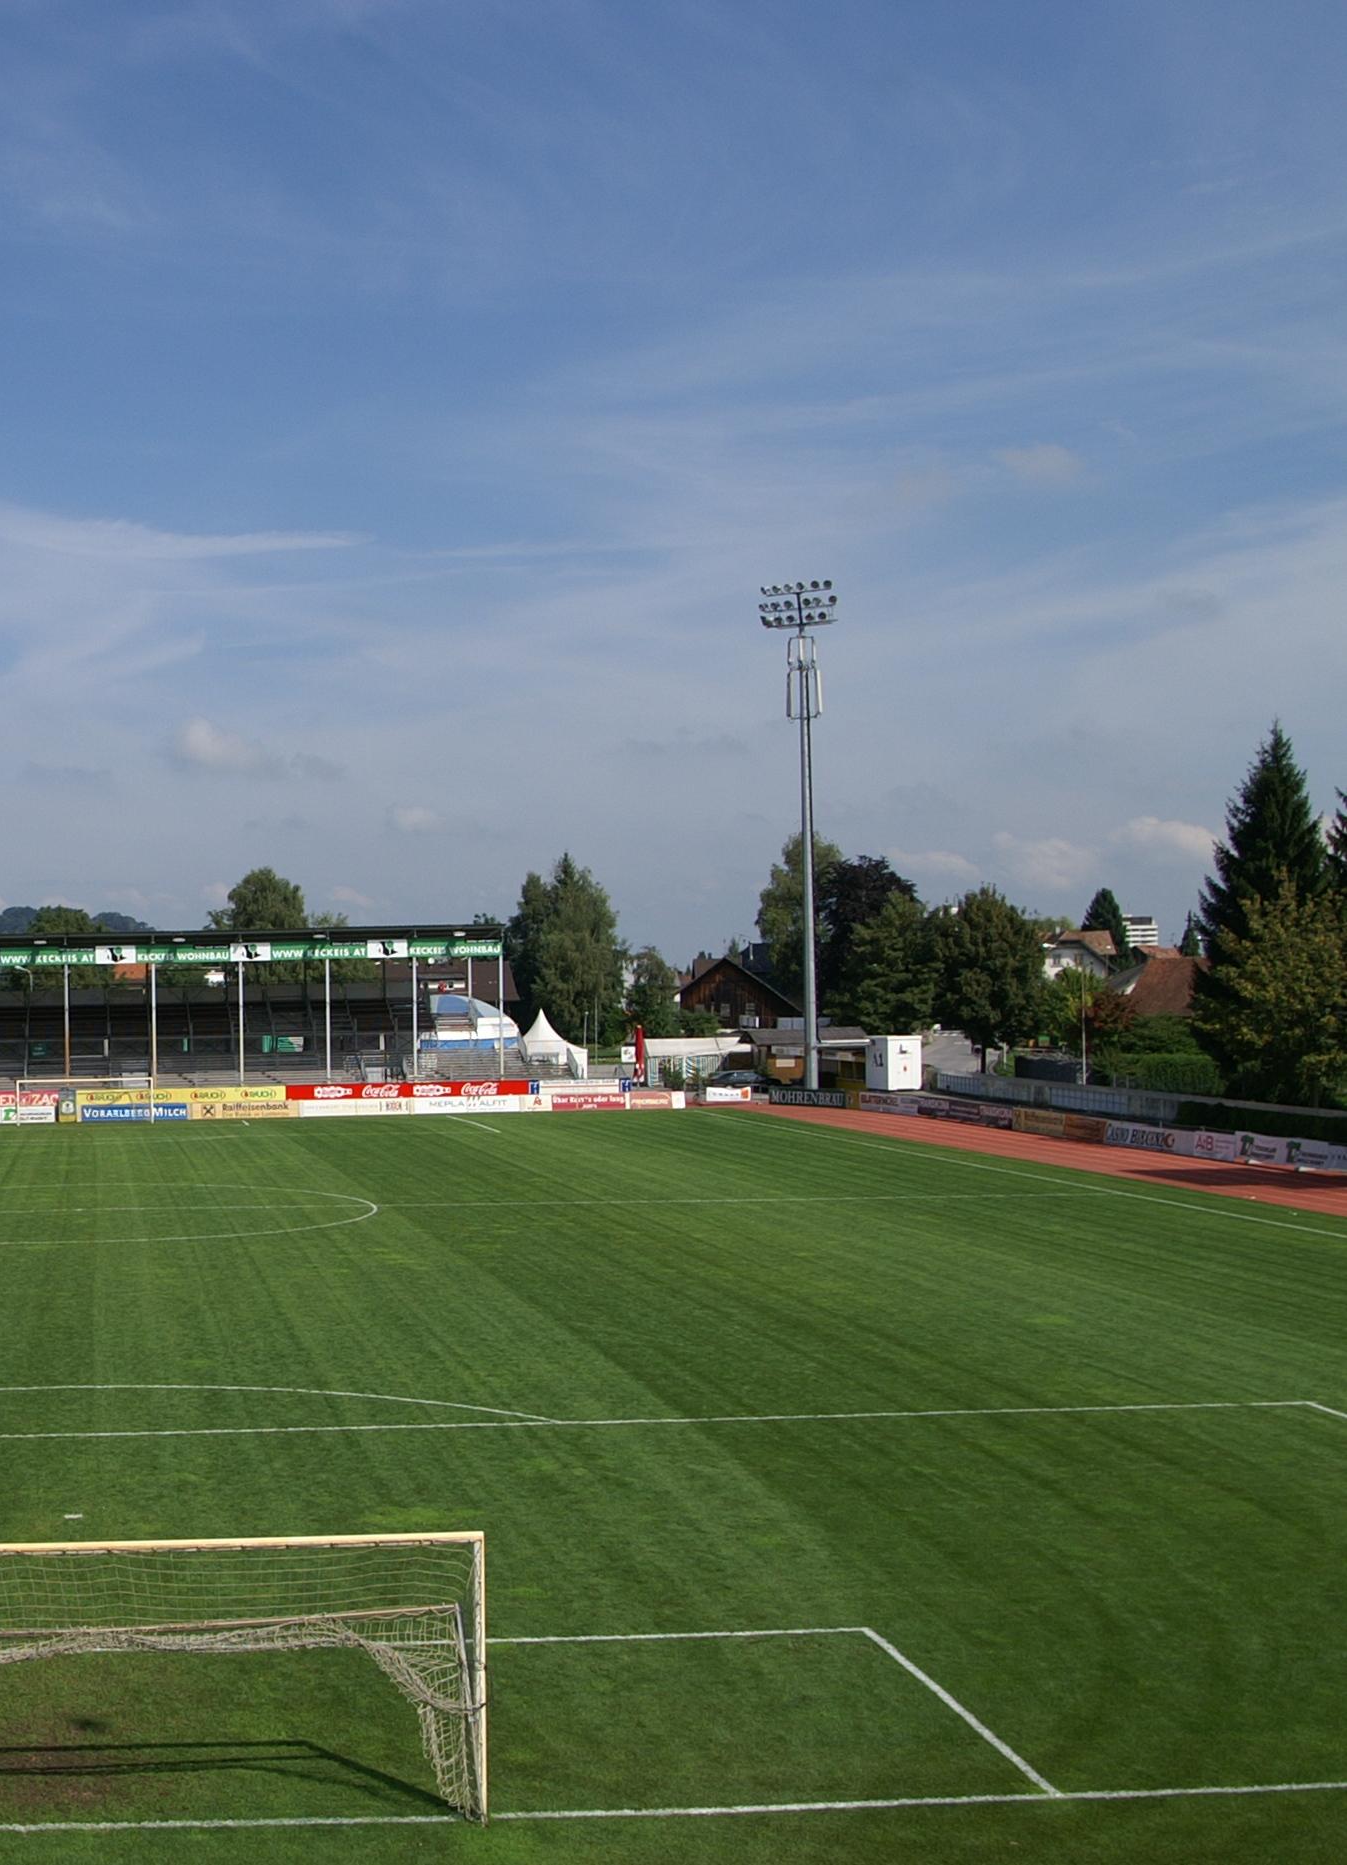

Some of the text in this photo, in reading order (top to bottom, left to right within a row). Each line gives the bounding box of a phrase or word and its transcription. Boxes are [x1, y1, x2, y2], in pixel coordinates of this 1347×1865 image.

[176, 951, 229, 961] WOHNBAU
[153, 1106, 186, 1117] MILCH
[222, 1102, 289, 1111] Raiffeisenbank
